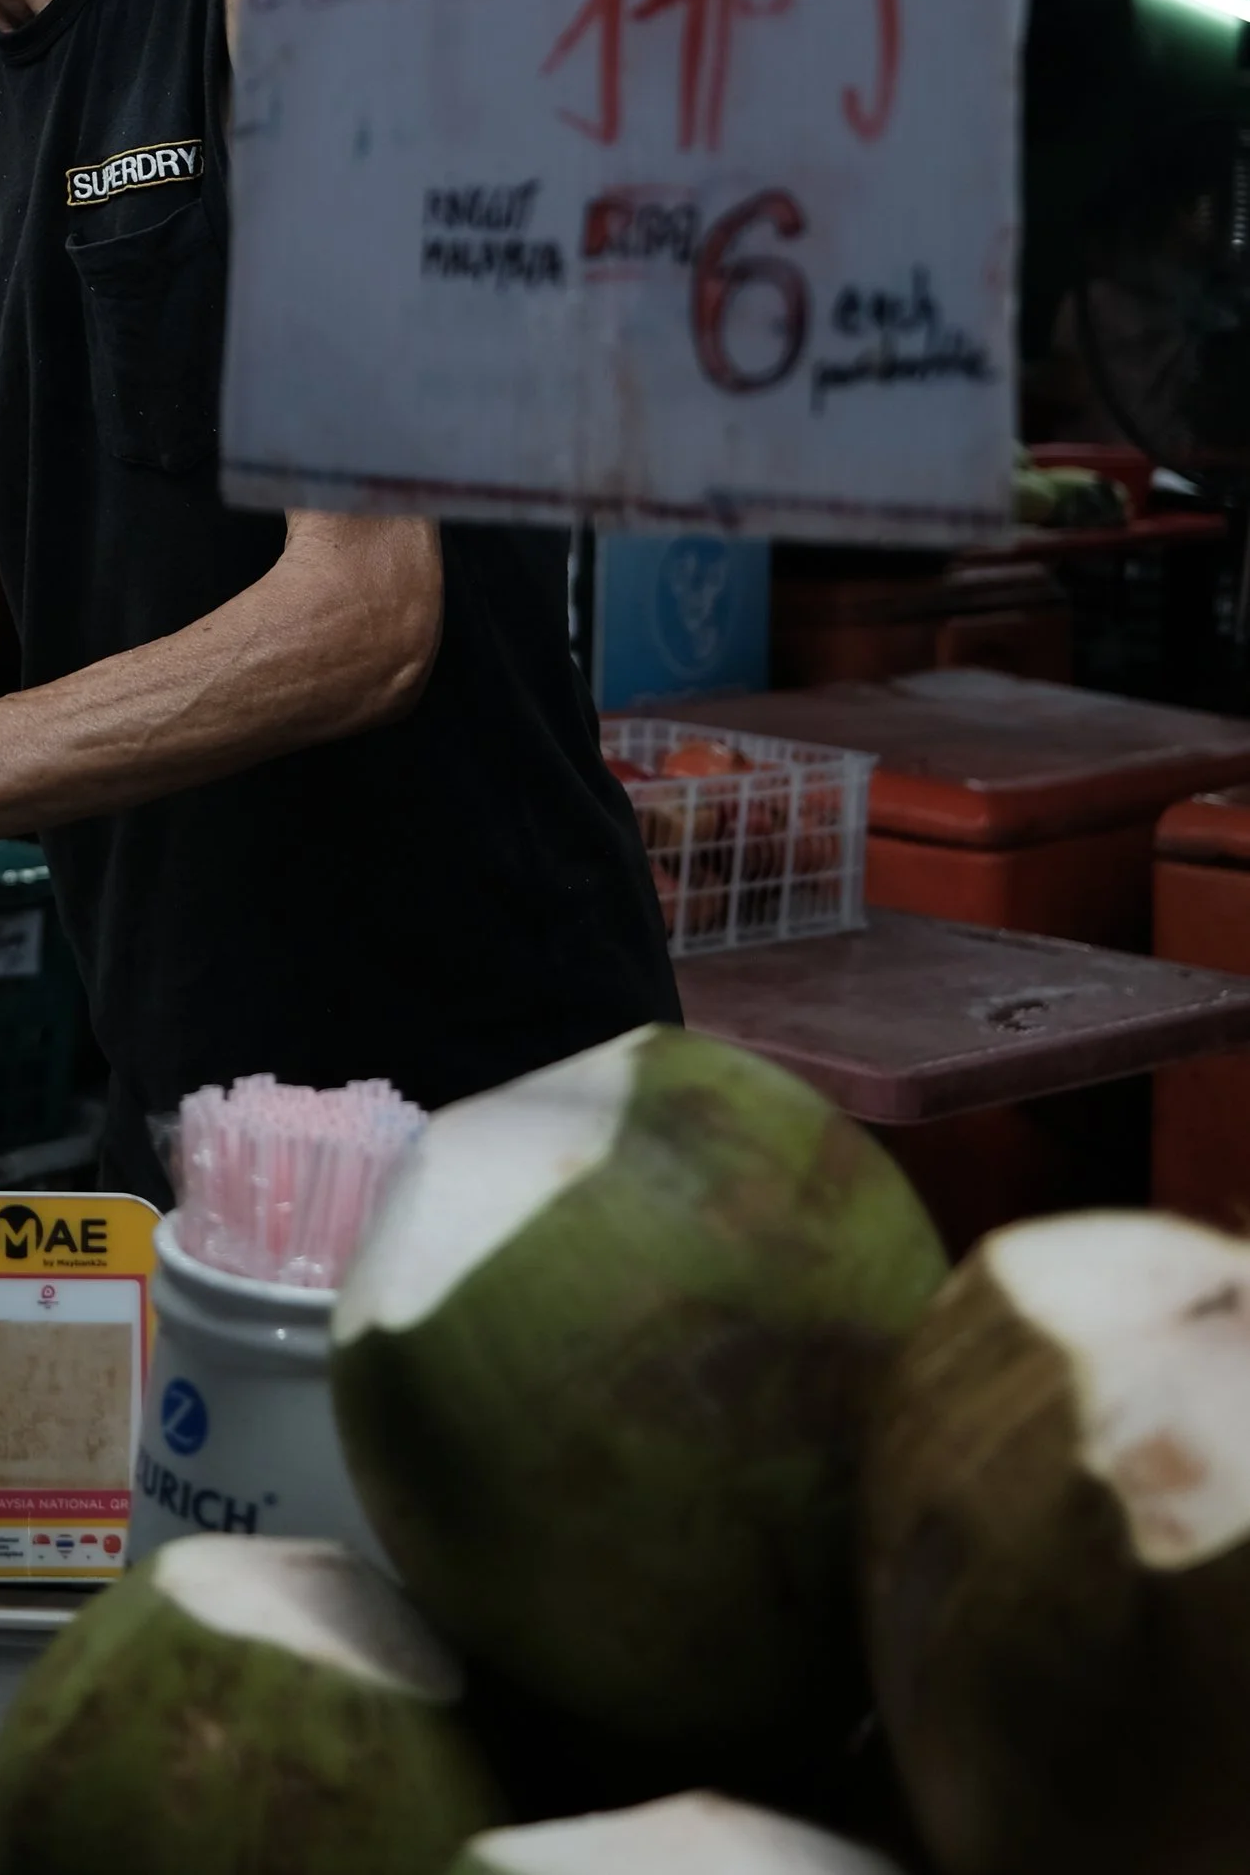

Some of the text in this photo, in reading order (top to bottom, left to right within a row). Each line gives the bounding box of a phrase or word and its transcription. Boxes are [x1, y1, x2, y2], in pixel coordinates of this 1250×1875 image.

[38, 1498, 106, 1511] NATIONAL
[110, 1498, 129, 1511] QR
[138, 1451, 258, 1535] URICH
